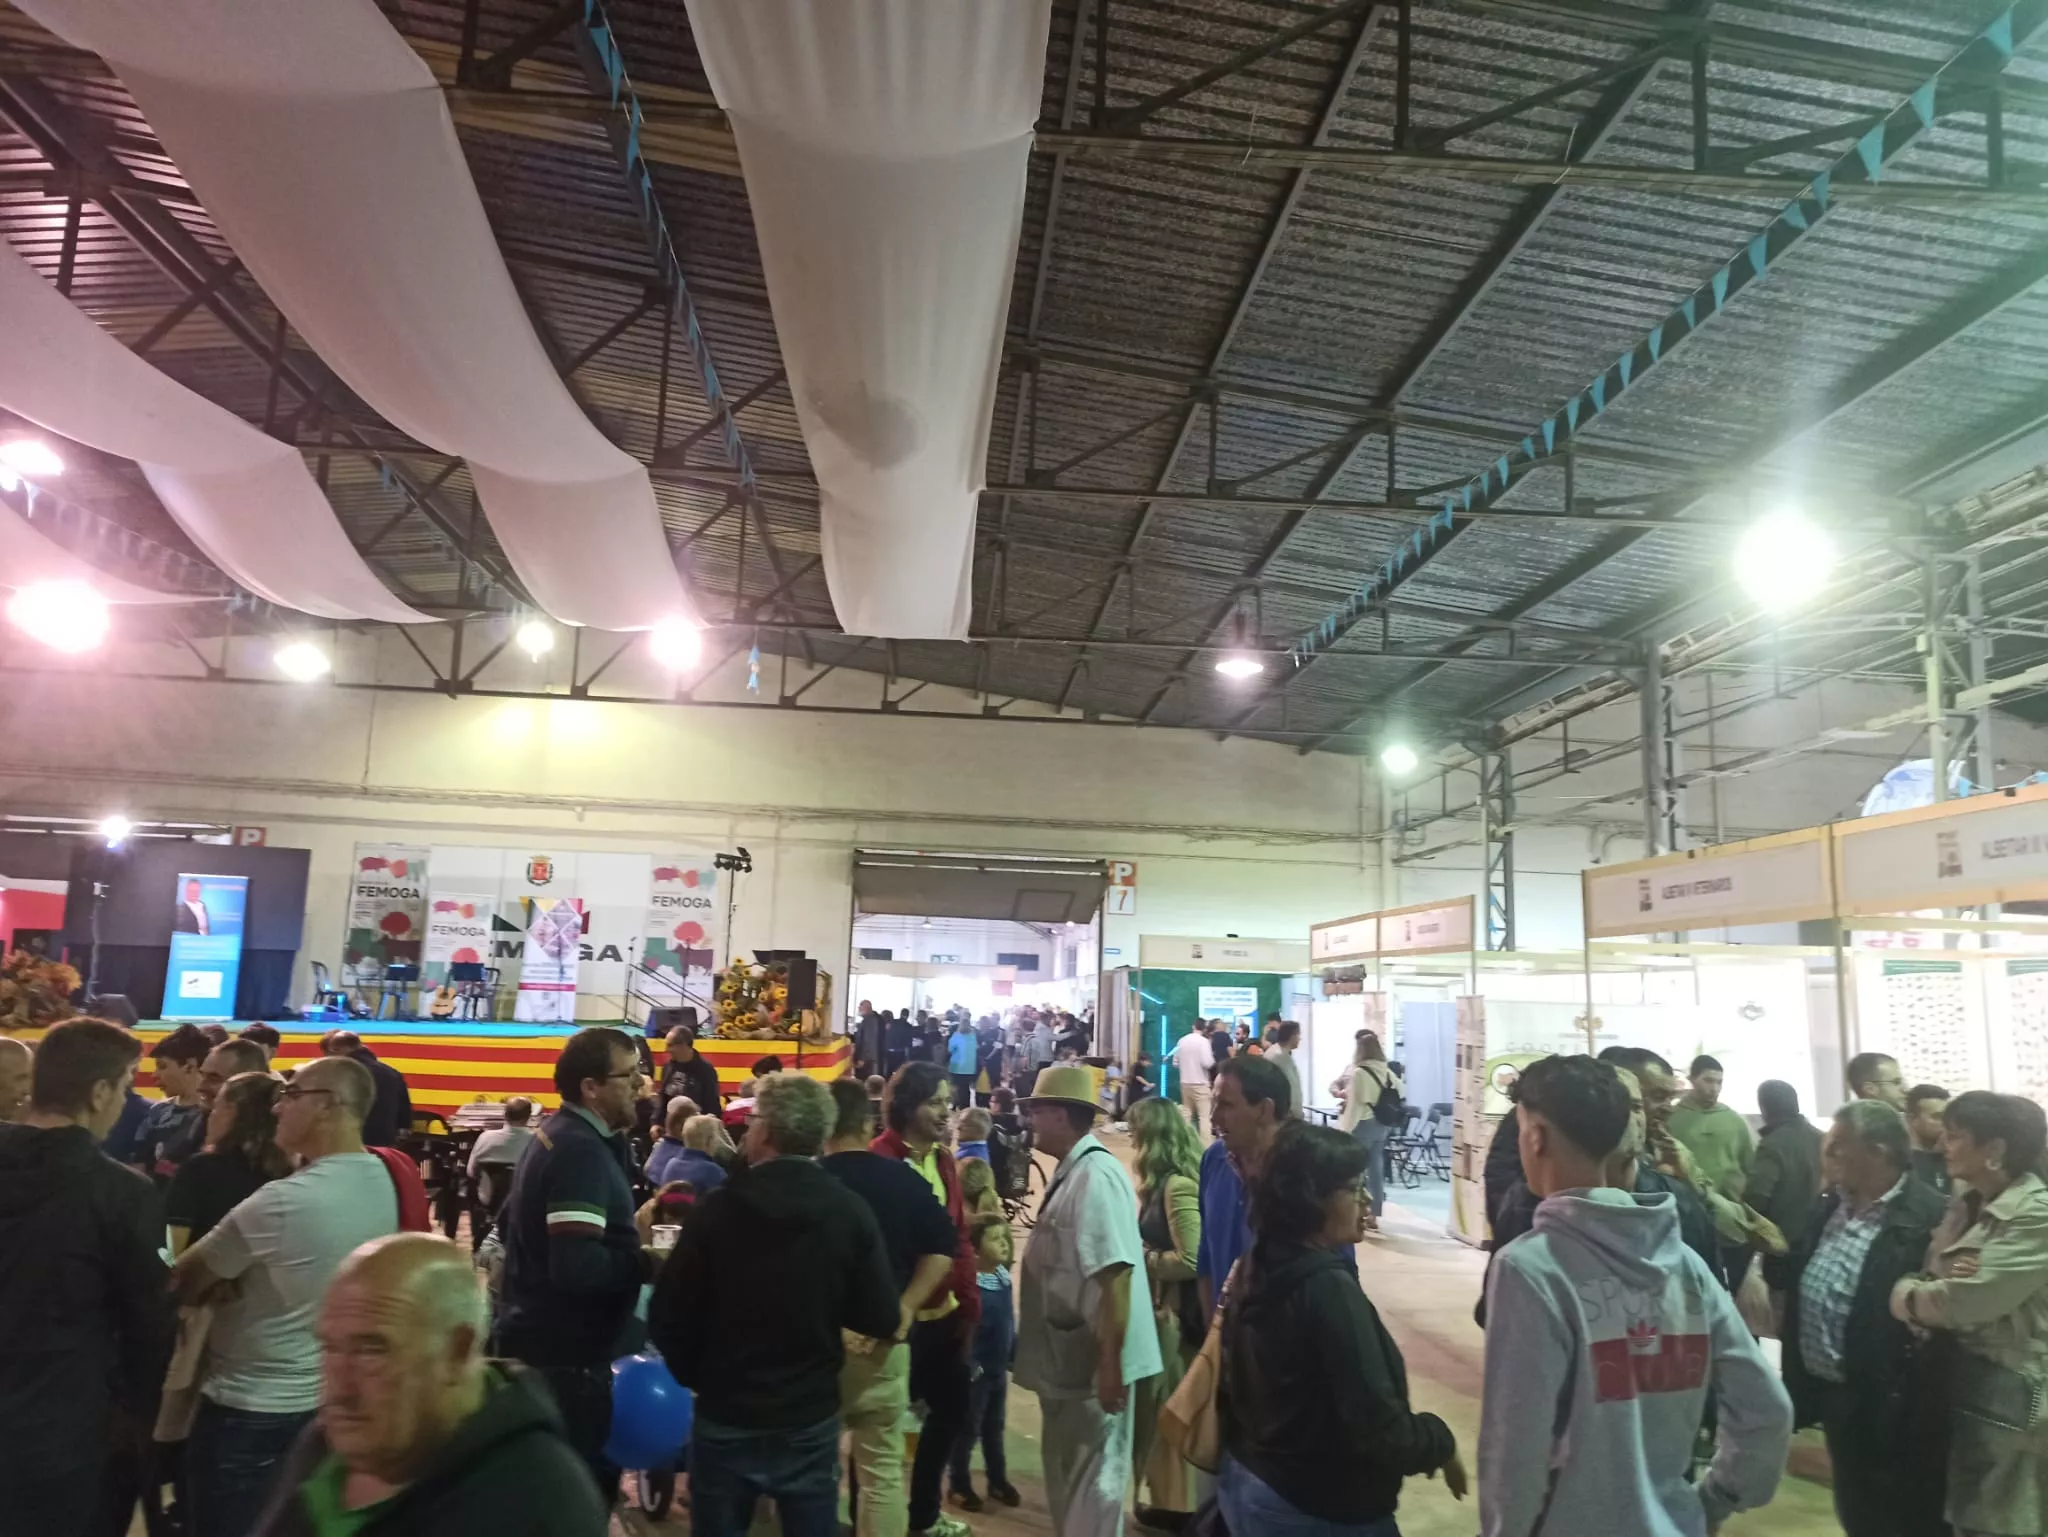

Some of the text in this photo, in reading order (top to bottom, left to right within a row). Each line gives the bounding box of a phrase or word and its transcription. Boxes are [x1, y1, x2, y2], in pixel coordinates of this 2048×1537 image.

[241, 828, 260, 846] P
[1114, 862, 1133, 883] P
[357, 886, 420, 899] FEMOGA
[1116, 889, 1128, 911] 7
[652, 895, 712, 909] FEMOGA
[432, 925, 486, 937] FEMOGA
